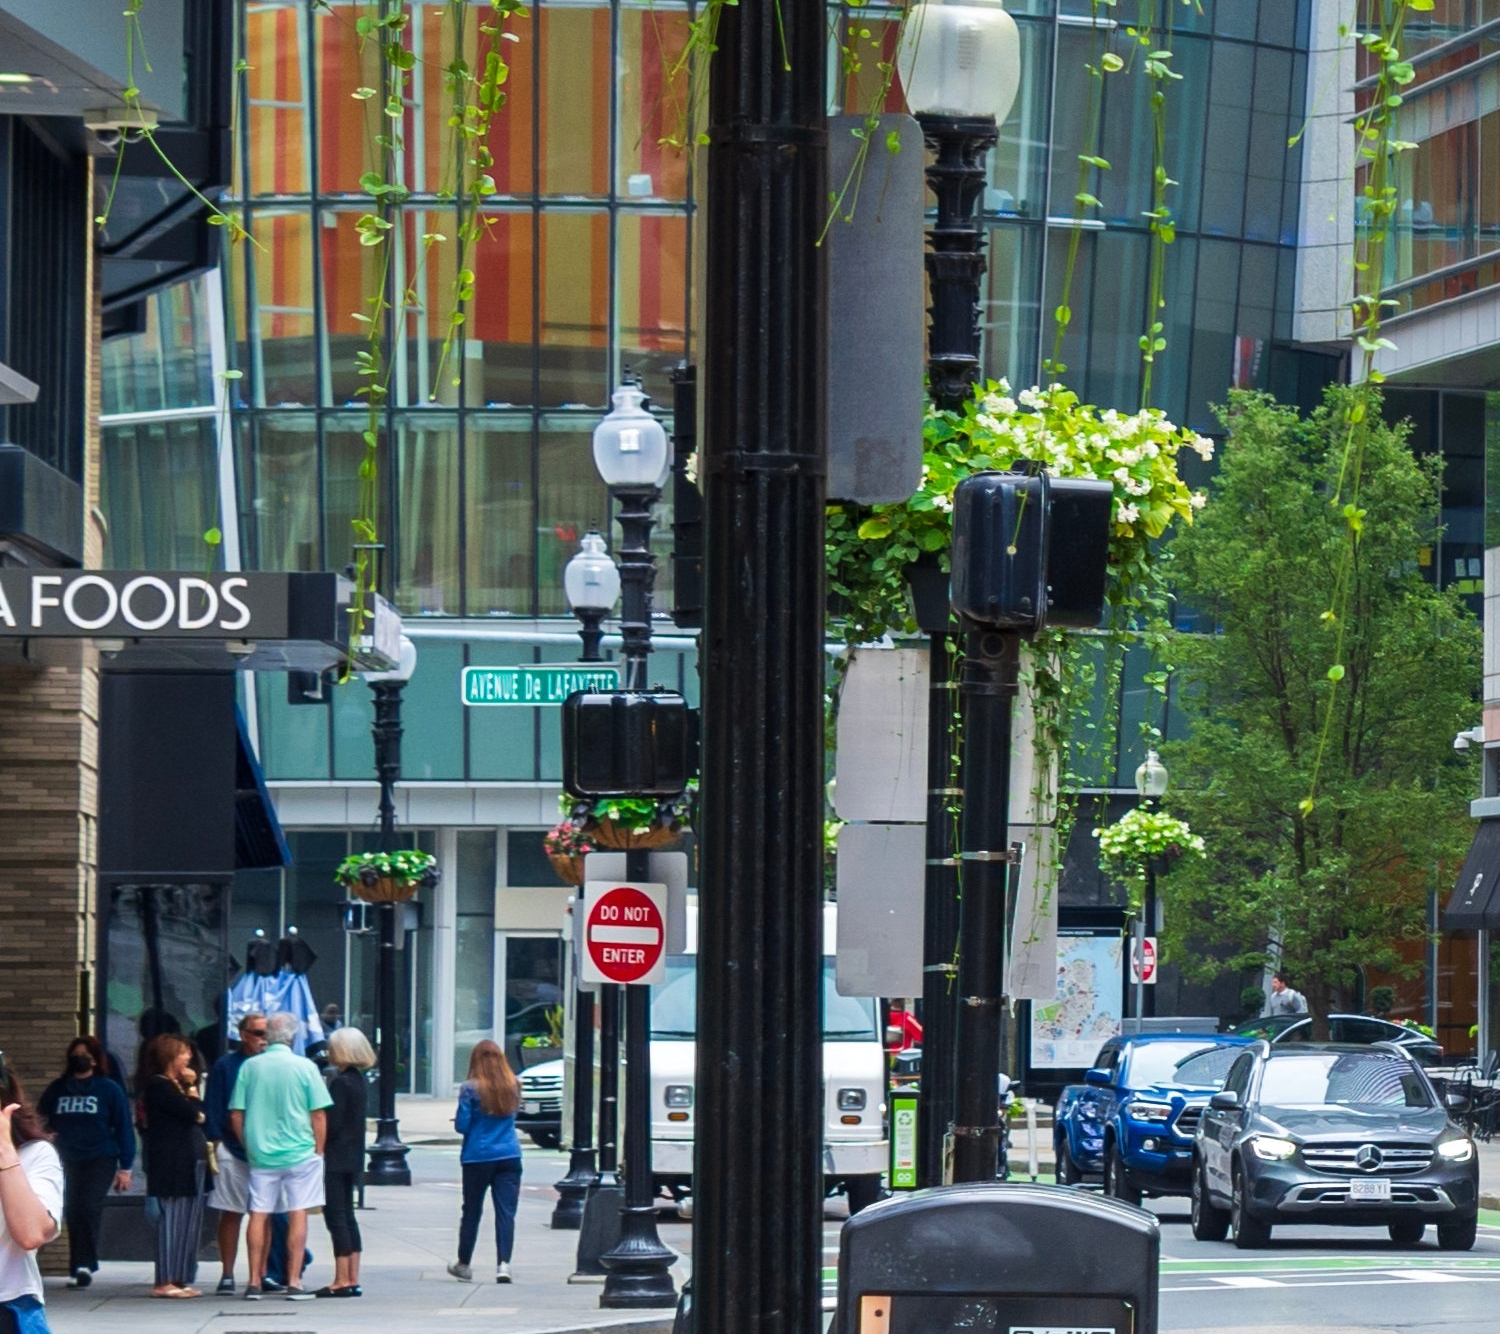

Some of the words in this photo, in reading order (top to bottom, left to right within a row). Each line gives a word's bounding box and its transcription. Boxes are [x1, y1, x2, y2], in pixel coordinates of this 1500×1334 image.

[31, 575, 252, 630] FOODS
[470, 673, 518, 700] AVENUE
[525, 673, 541, 700] De
[600, 905, 618, 920] DO
[624, 906, 650, 921] NOT
[603, 948, 645, 964] ENTER
[57, 1096, 97, 1113] RHS
